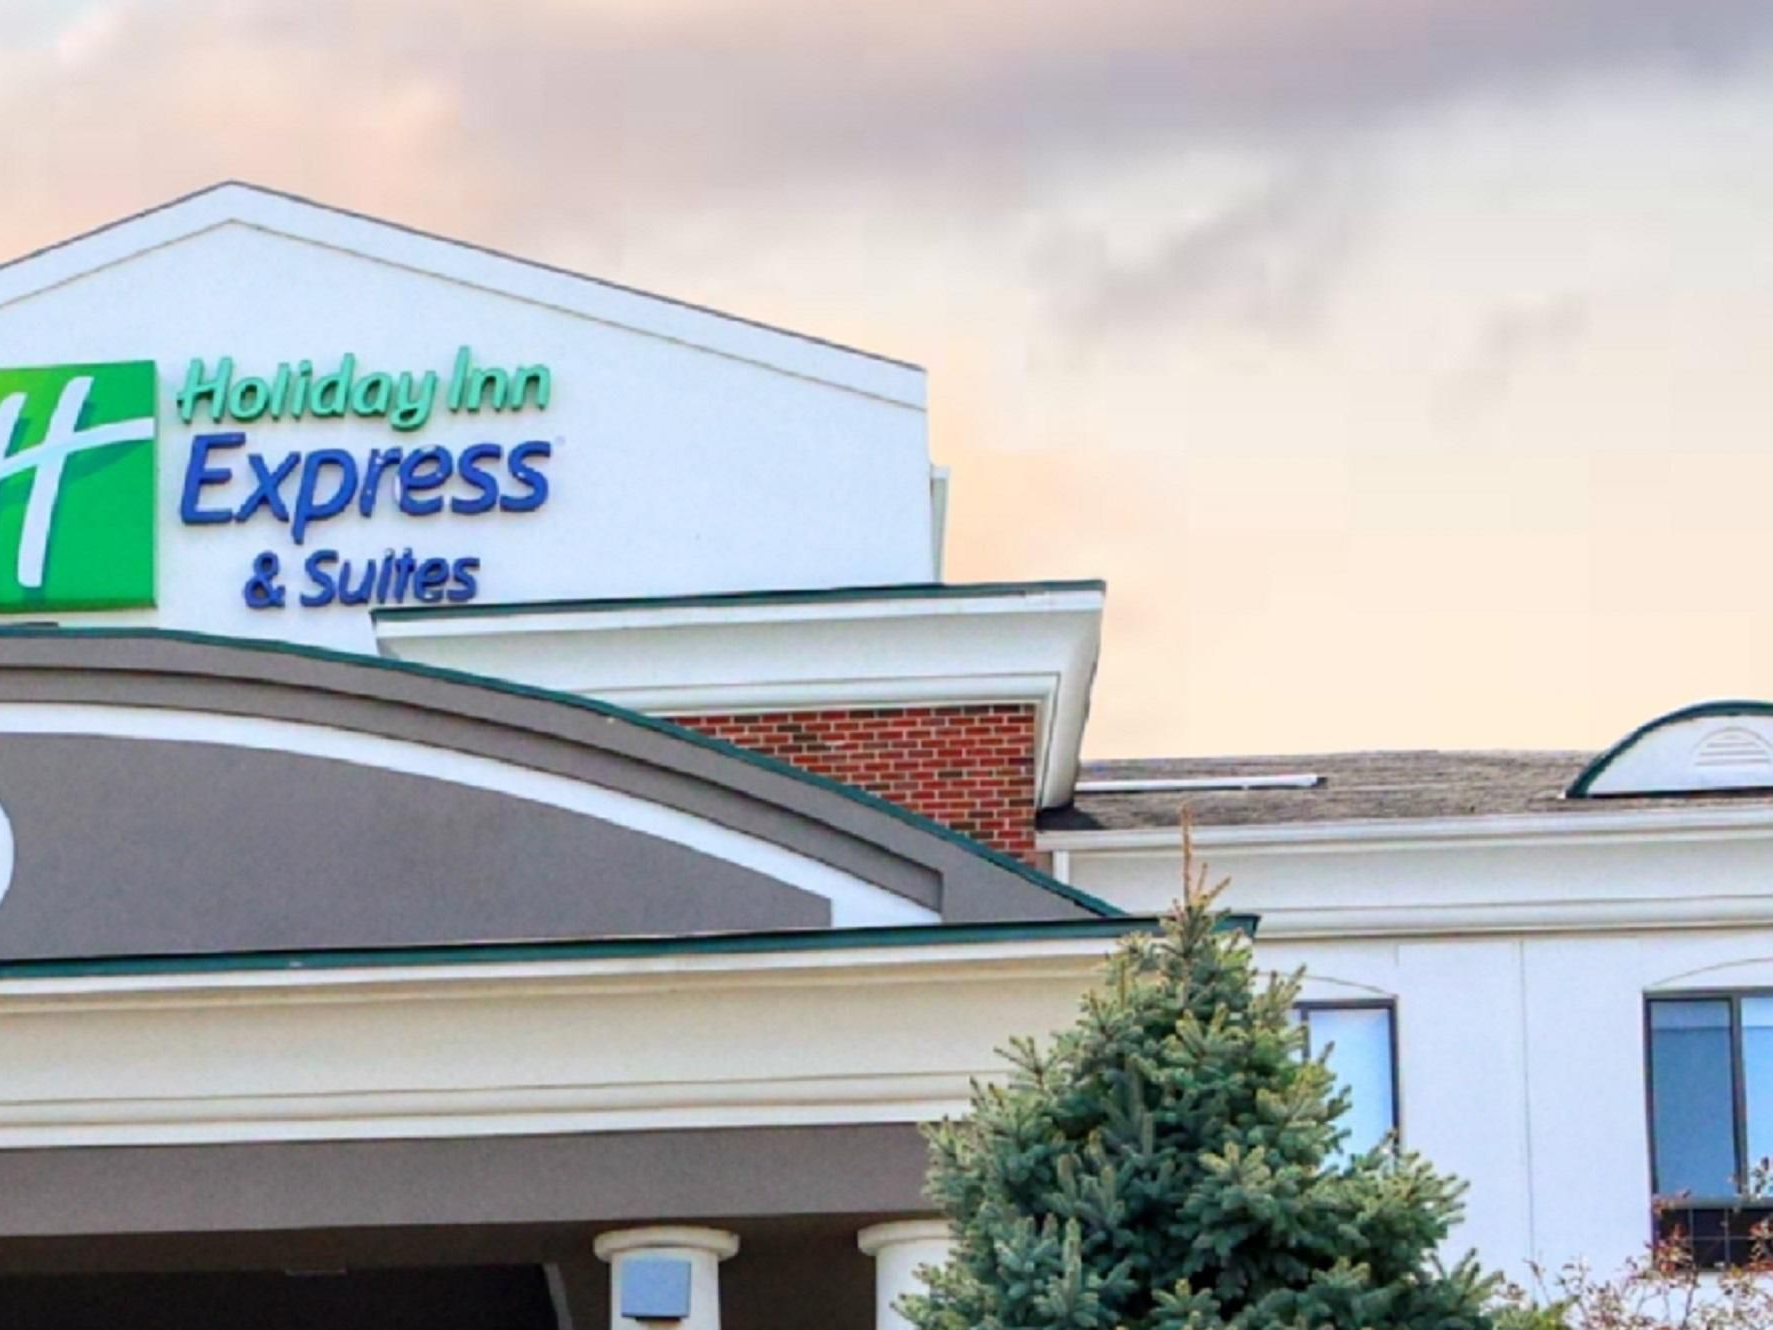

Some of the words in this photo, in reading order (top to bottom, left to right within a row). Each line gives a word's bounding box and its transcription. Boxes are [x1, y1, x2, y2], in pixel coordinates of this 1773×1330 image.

[177, 353, 436, 431] Holiday
[446, 346, 552, 412] Inn
[179, 432, 552, 545] Express
[244, 552, 285, 609] &
[300, 548, 480, 609] Suites
